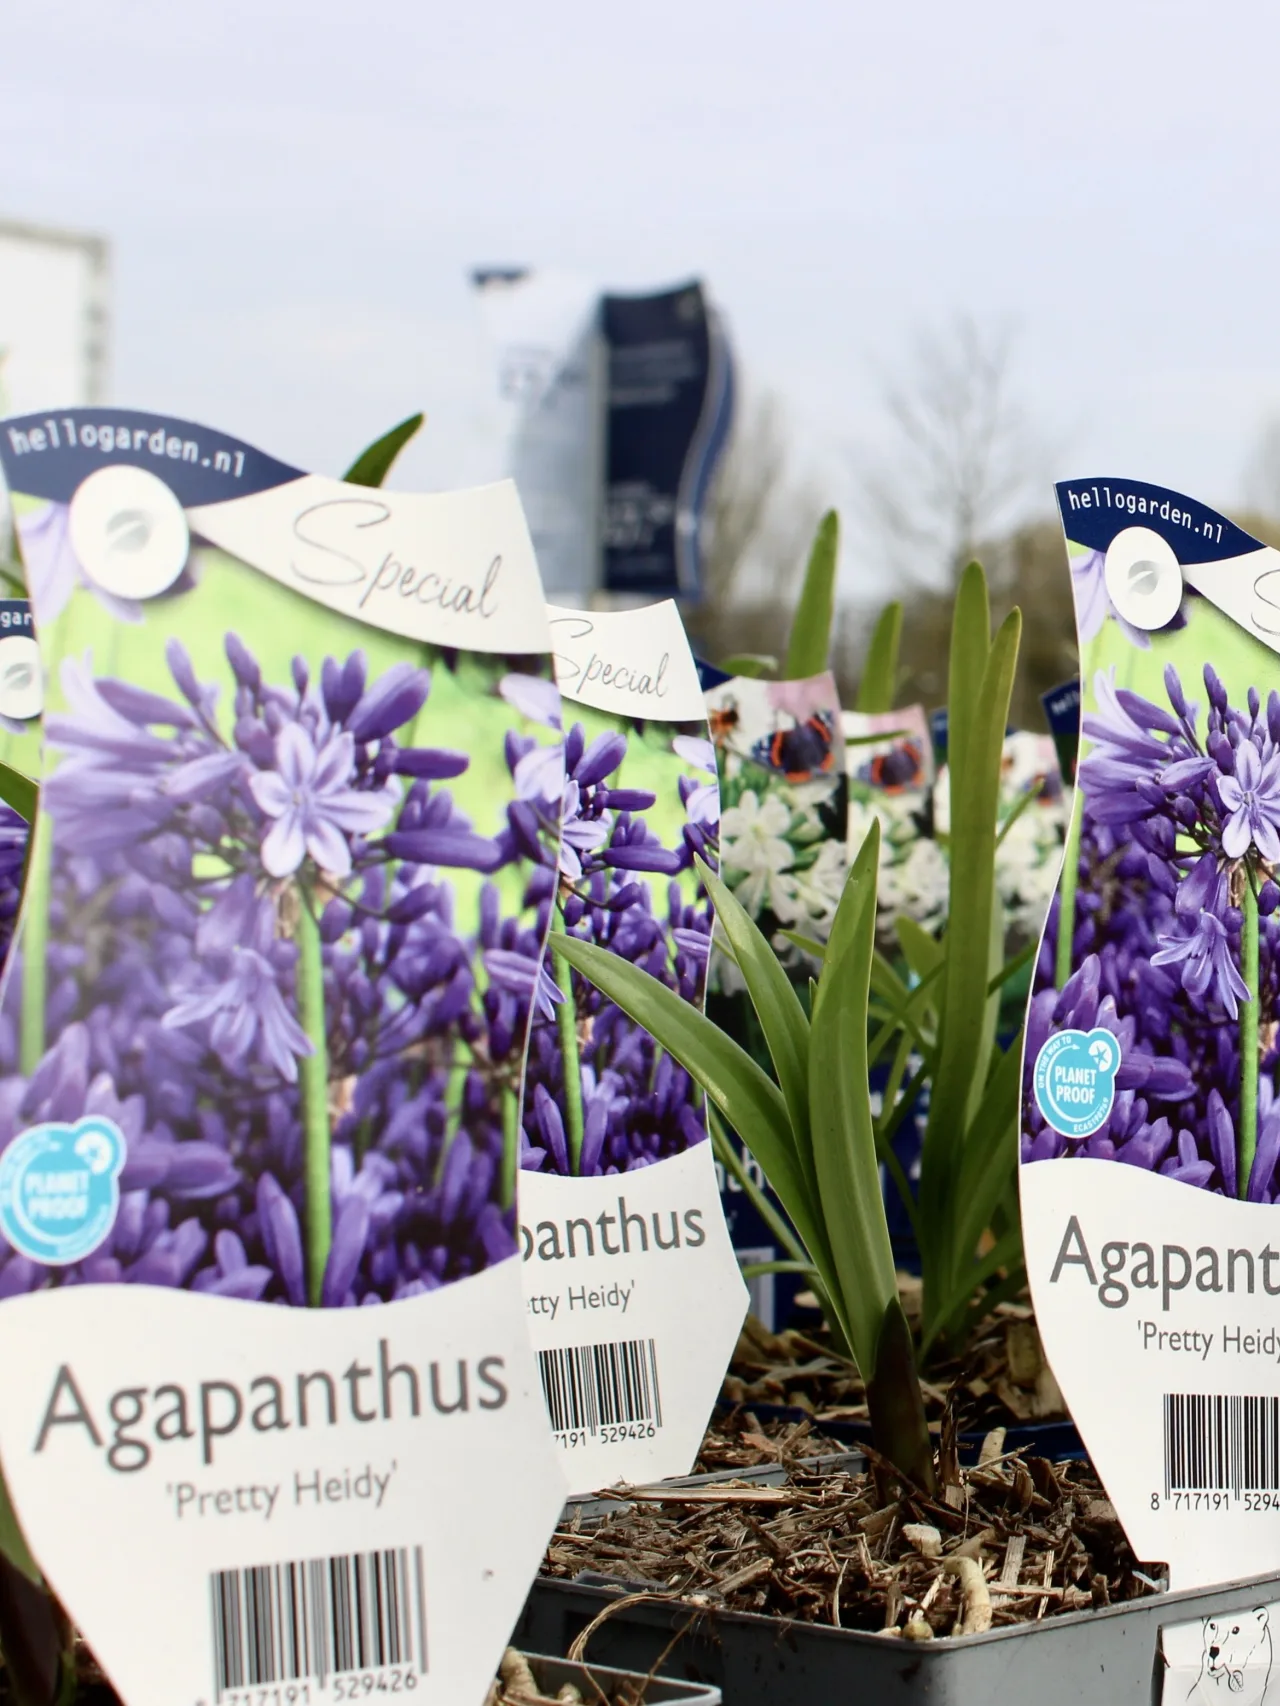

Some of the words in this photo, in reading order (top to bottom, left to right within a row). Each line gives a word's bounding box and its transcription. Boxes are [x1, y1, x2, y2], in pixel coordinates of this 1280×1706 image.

[8, 418, 245, 478] hellogarden.nl
[1068, 487, 1222, 543] hellogarden.nl
[290, 499, 502, 618] Special
[1055, 1066, 1097, 1086] PLANET
[1056, 1085, 1096, 1105] PROOF
[520, 1196, 706, 1262] anthus
[568, 1279, 635, 1313] Heidy'
[1137, 1320, 1214, 1361] 'Pretty
[33, 1338, 509, 1472] Agapanthus
[600, 1423, 656, 1444] 529426
[166, 1481, 280, 1519] 'Pretty
[294, 1459, 398, 1508] Heidy'
[1150, 1492, 1160, 1511] 8
[1173, 1492, 1230, 1511] 717191
[333, 1669, 418, 1702] 529426
